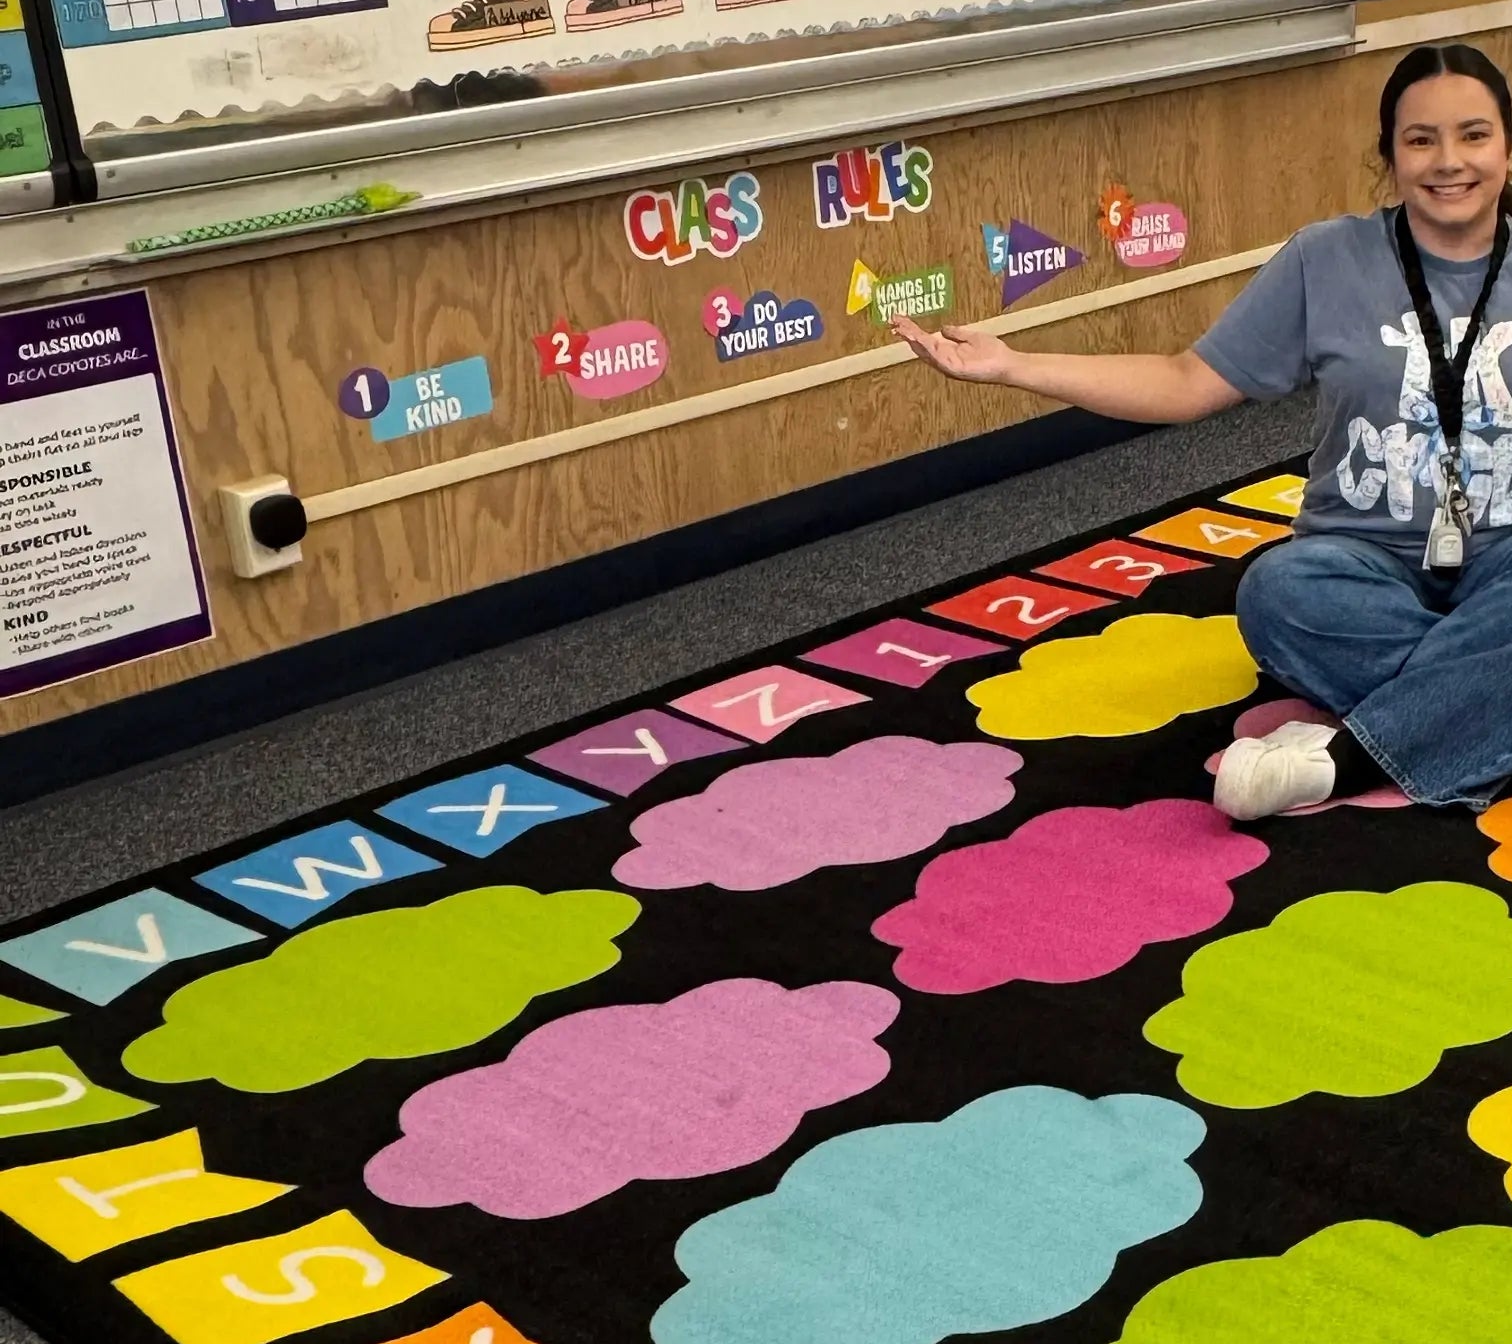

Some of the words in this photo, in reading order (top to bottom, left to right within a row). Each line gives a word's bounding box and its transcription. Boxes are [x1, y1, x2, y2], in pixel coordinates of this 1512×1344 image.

[629, 176, 761, 260] CLASS
[816, 146, 932, 224] RULES
[1109, 200, 1121, 227] 6
[1131, 213, 1171, 236] RAISE
[992, 235, 1005, 264] 5
[1007, 246, 1067, 277] LISTEN
[854, 274, 872, 299] 4
[876, 278, 924, 305] HANDS
[928, 273, 946, 293] TO
[711, 296, 732, 327] 3
[752, 298, 778, 324] DO
[878, 291, 946, 322] YOURSELF
[18, 326, 121, 361] CLASSROOM
[551, 332, 572, 365] 2
[720, 323, 770, 354] YOUR
[775, 315, 815, 342] BEST
[7, 366, 46, 386] DECA
[49, 354, 111, 378] COYOTES
[579, 339, 660, 380] SHARE
[354, 374, 373, 412] 1
[415, 373, 446, 401] BE
[405, 397, 463, 432] KIND
[1198, 522, 1262, 546] 4
[1088, 554, 1165, 583] 3
[4, 610, 49, 631] KIND
[986, 594, 1070, 626] 2
[874, 641, 952, 669] 1
[711, 682, 831, 729] Z
[581, 727, 669, 766] Y
[426, 782, 558, 836] X
[231, 834, 384, 901] W
[64, 913, 168, 965] V
[56, 1167, 202, 1220] T
[220, 1245, 386, 1306] S
